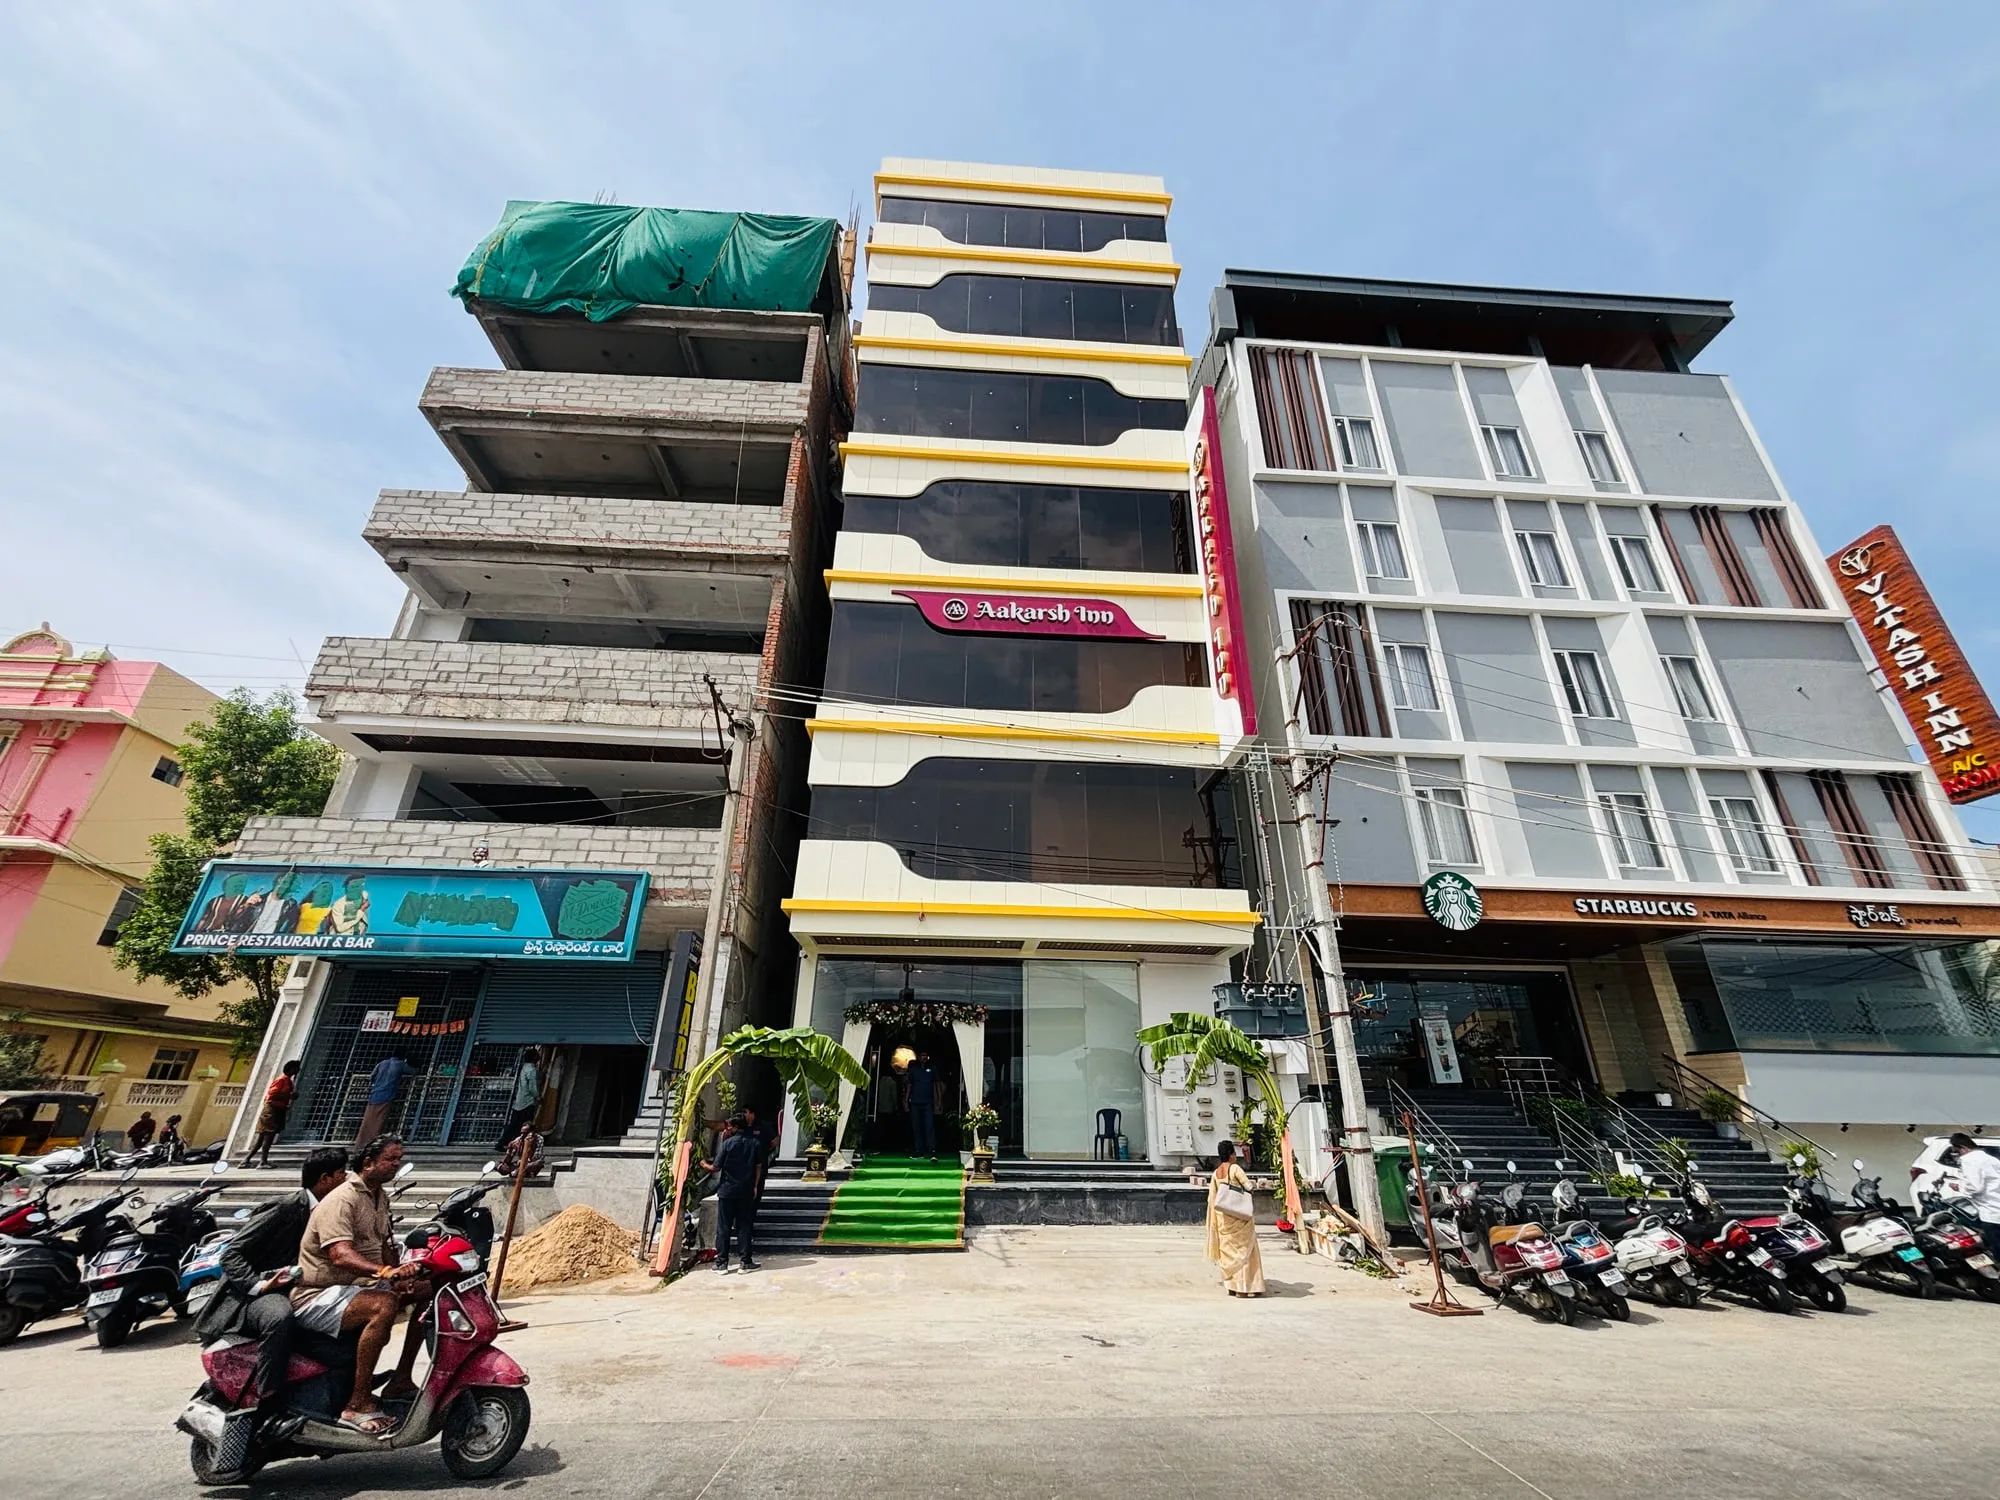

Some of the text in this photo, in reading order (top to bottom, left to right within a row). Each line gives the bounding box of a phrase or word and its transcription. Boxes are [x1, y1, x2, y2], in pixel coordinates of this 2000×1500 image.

[974, 601, 1071, 624] Aakarsh
[1074, 606, 1115, 625] Inn
[1855, 572, 1972, 754] VITASH INN
[1953, 753, 1987, 774] A/C
[1942, 763, 2000, 796] ROOM
[1575, 898, 1698, 917] STARBUCKS
[182, 934, 375, 948] PRINCE RESTAURANT & BAR
[673, 970, 698, 1070] BAR
